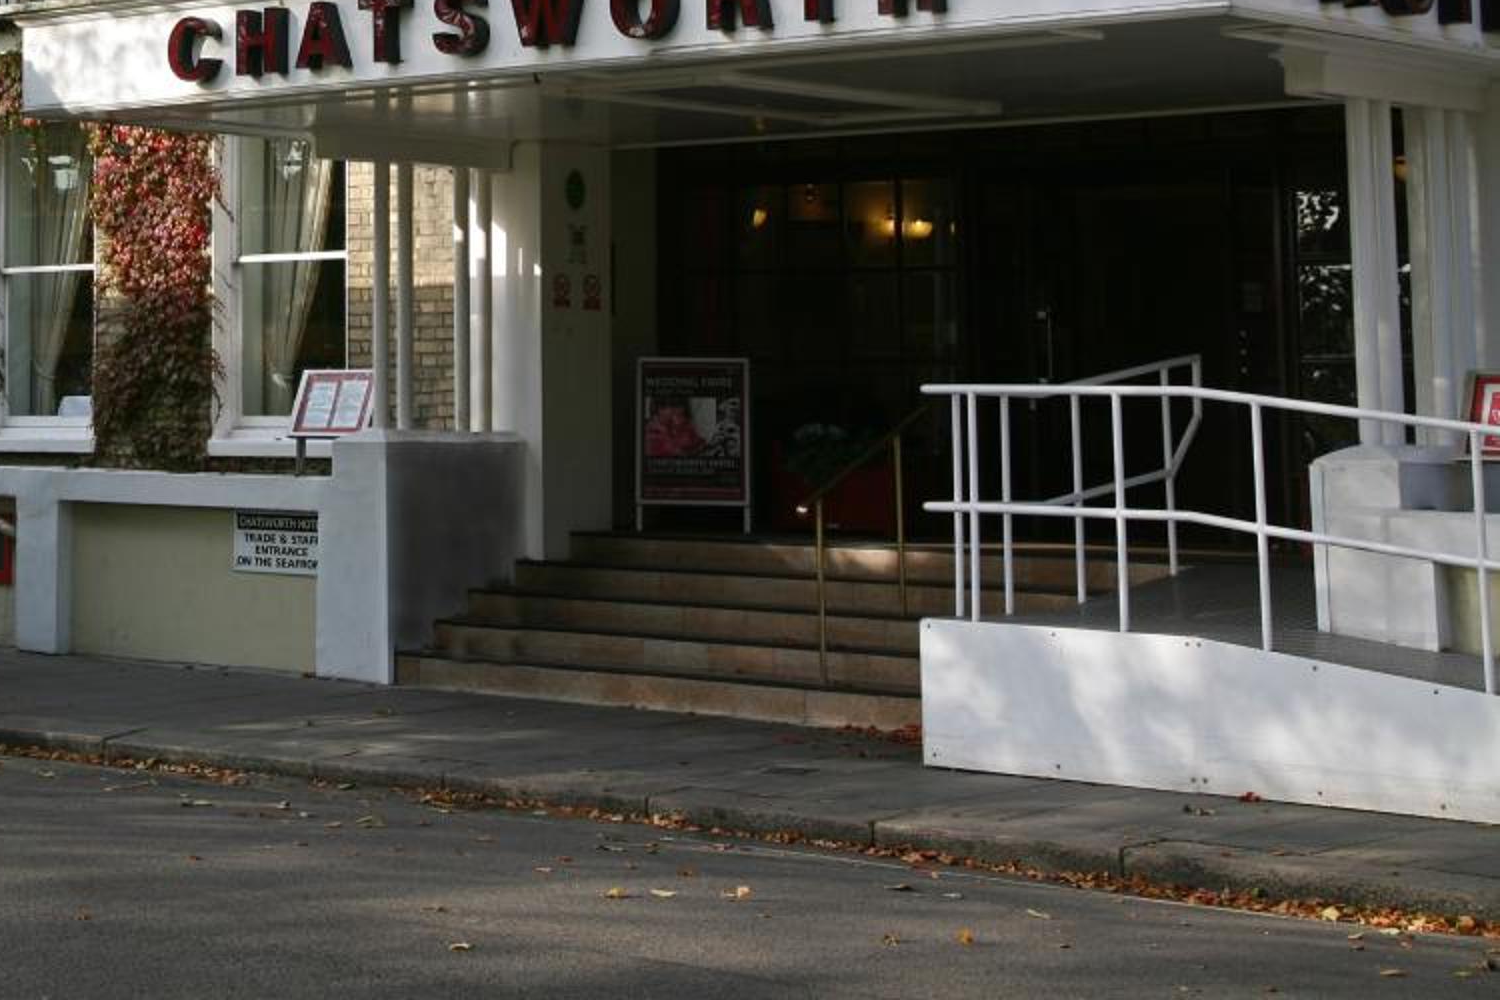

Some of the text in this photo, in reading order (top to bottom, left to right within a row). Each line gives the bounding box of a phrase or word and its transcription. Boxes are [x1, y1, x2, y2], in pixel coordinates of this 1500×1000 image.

[244, 533, 277, 544] TRADE
[280, 534, 288, 545] &
[255, 545, 309, 557] ENTRANCE
[237, 555, 252, 566] ON
[255, 556, 272, 567] THE
